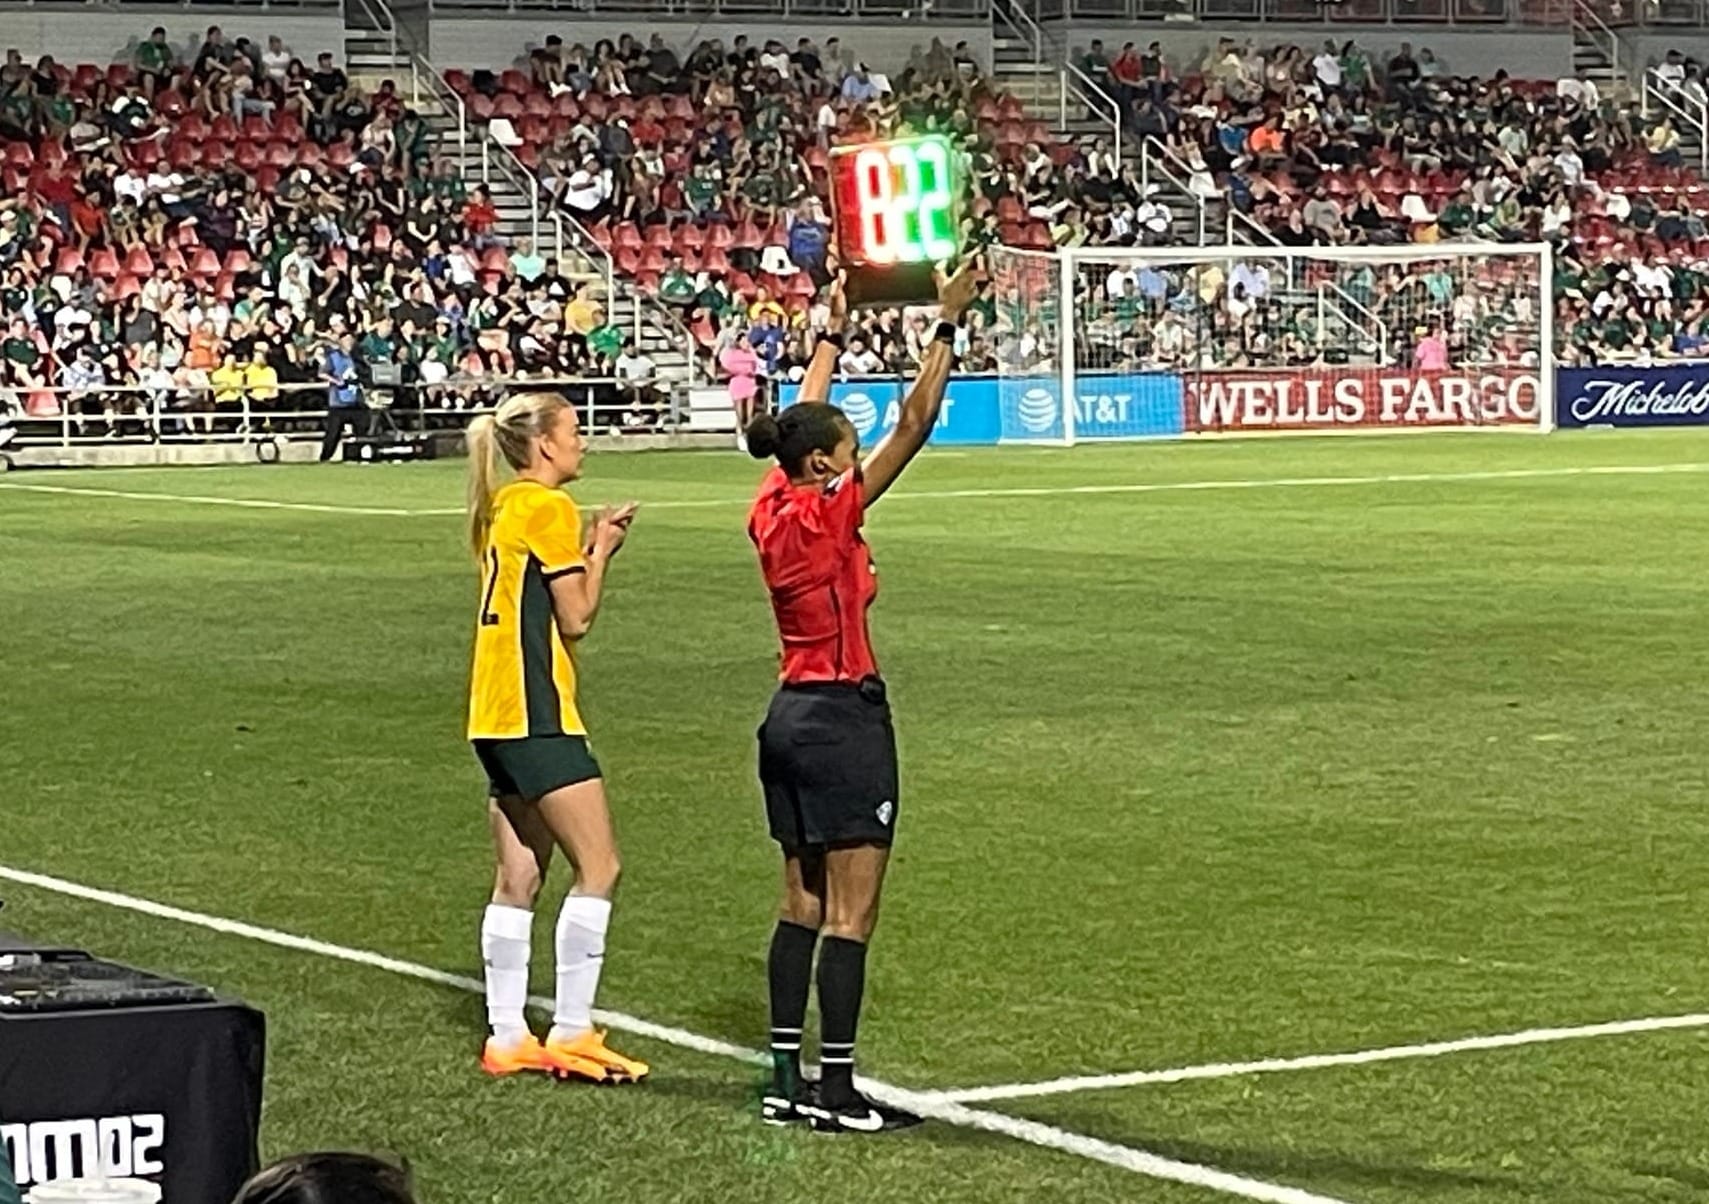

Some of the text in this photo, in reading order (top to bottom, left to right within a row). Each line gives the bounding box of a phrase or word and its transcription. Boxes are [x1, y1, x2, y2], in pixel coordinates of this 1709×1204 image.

[1189, 374, 1541, 426] WELLS FARGO
[1571, 380, 1709, 421] Michelob
